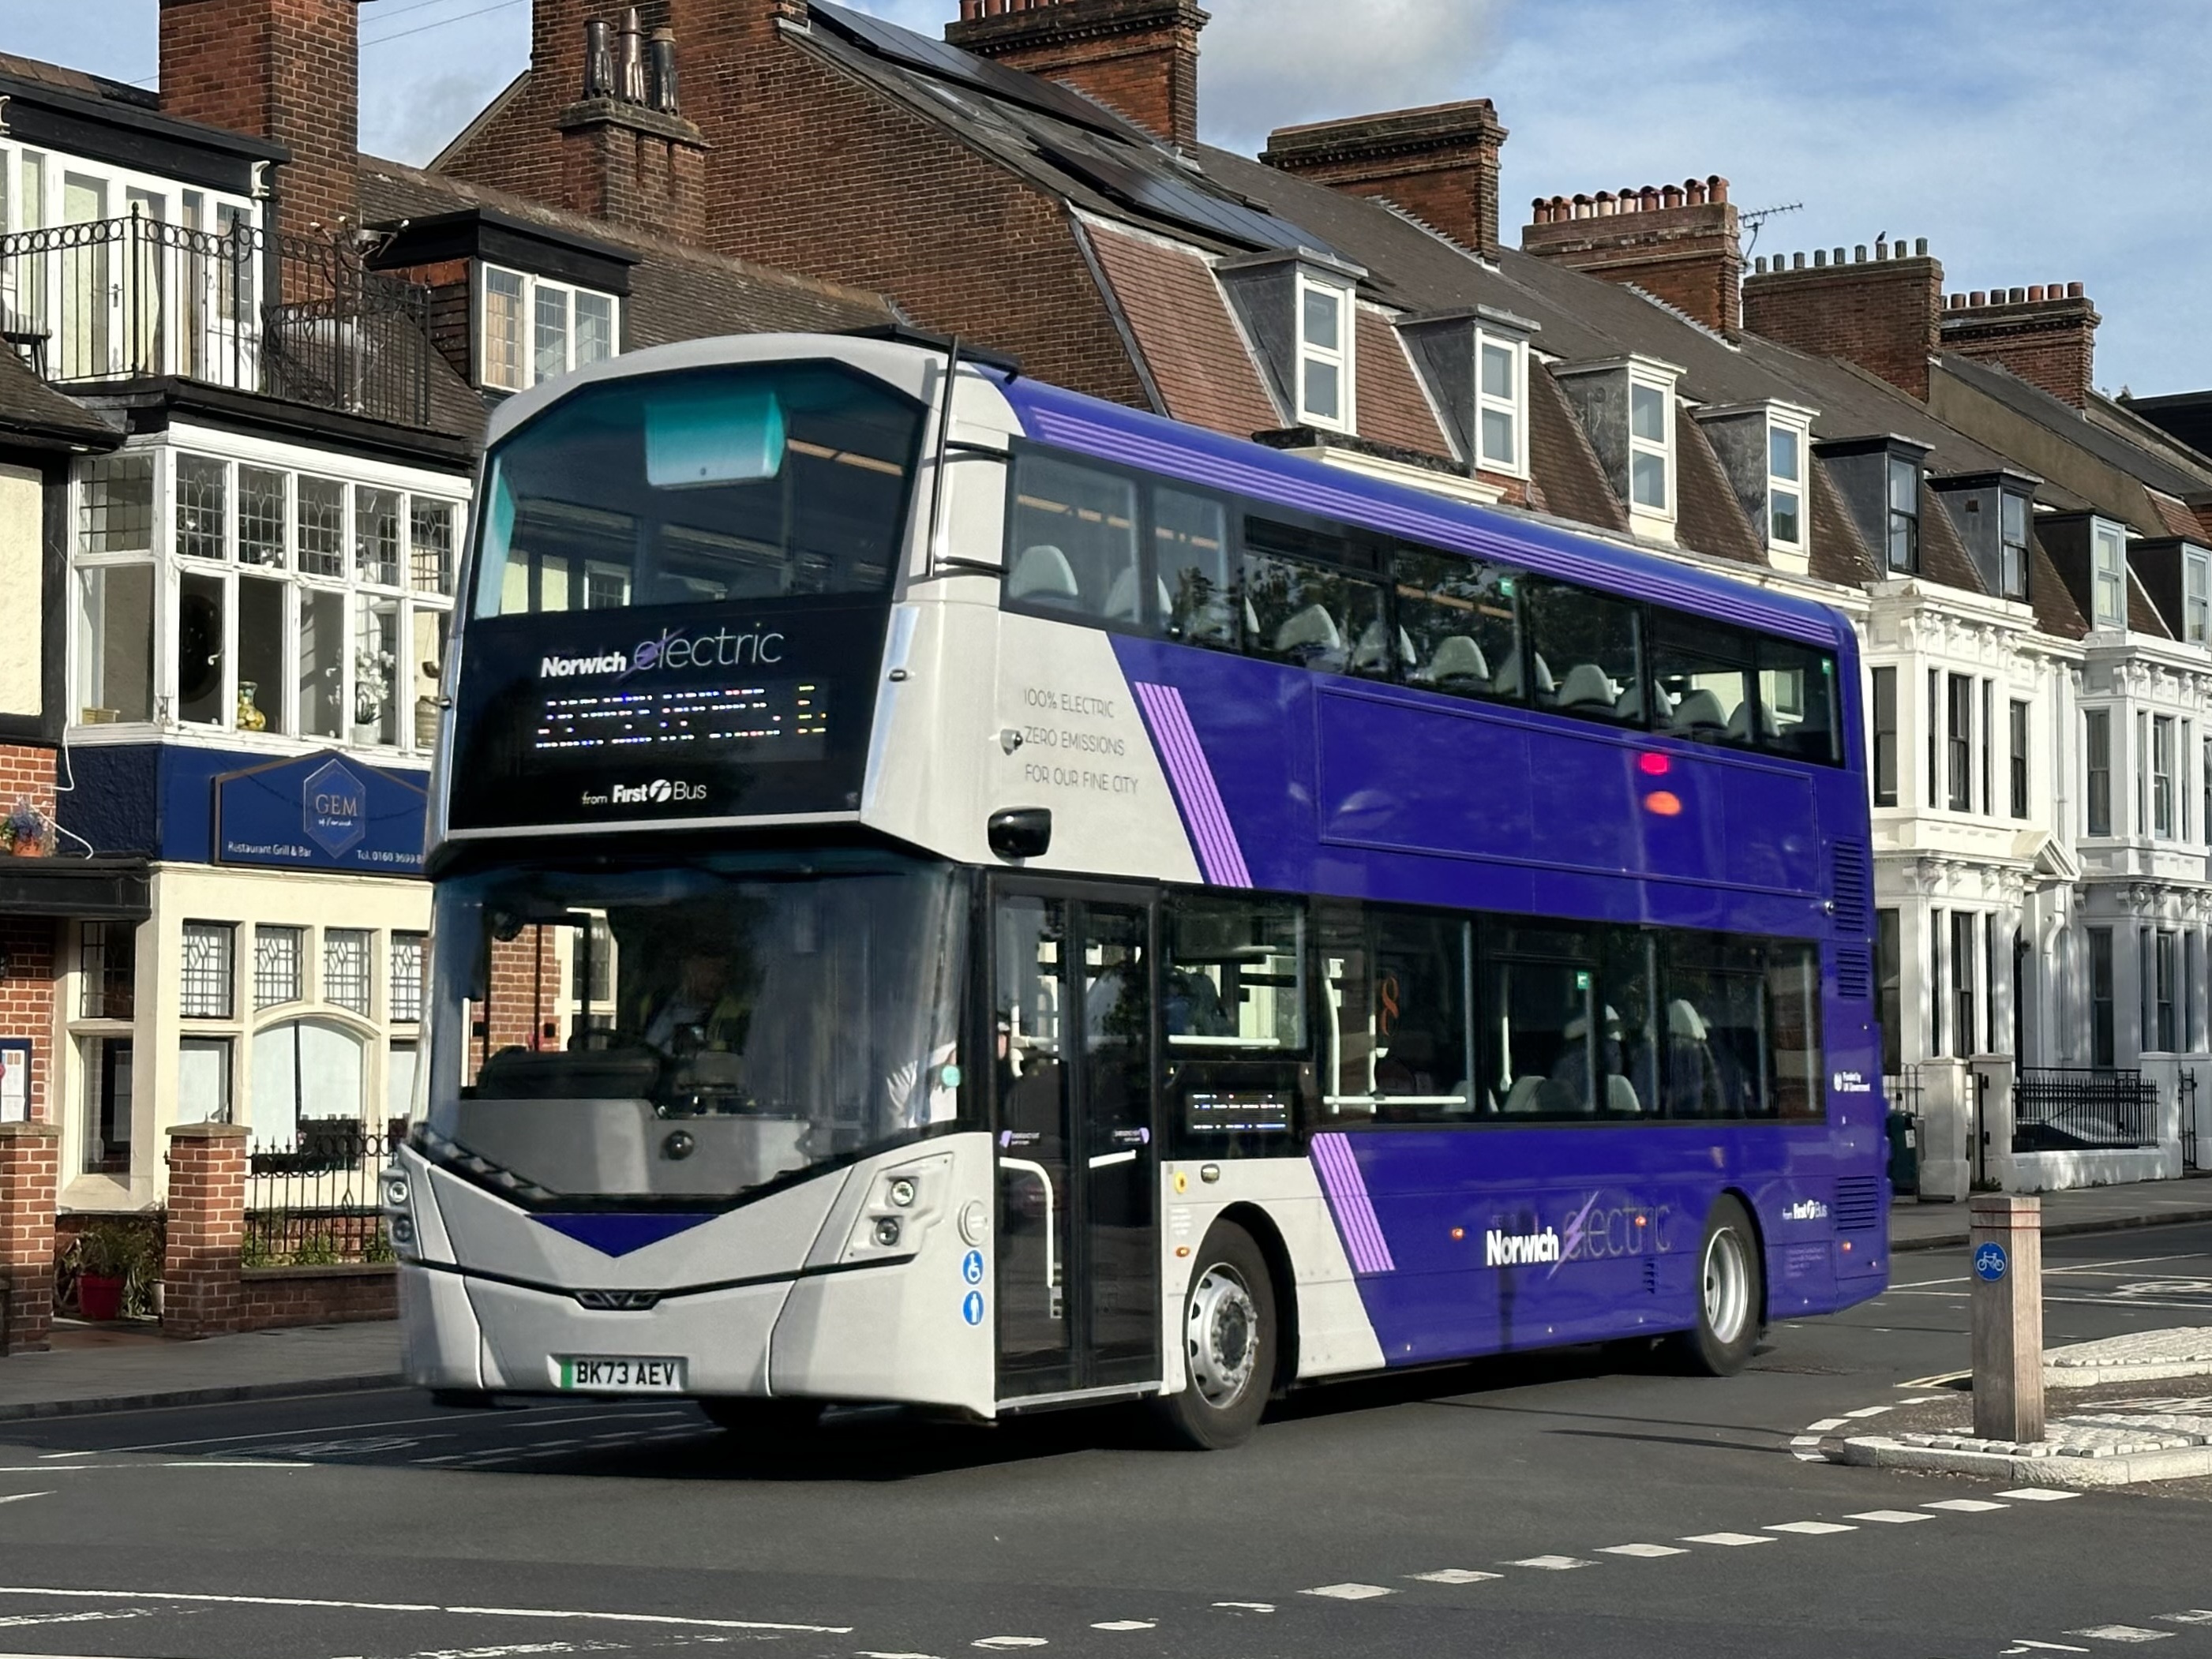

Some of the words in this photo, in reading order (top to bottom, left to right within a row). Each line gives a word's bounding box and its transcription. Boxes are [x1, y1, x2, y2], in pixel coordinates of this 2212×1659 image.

[541, 651, 628, 678] Norwich
[634, 622, 785, 670] electric
[1024, 688, 1057, 710] 100%
[1061, 694, 1115, 718] ELECTRIC
[1024, 726, 1057, 747] ZERO
[1061, 731, 1125, 756] EMISSIONS
[1025, 763, 1050, 784] FOR
[1054, 767, 1079, 787] OUR
[1082, 771, 1109, 791] FINE
[1112, 775, 1138, 794] CITY
[316, 794, 358, 816] GEM
[582, 791, 608, 805] from
[612, 784, 648, 803] First
[673, 781, 707, 800] Bus
[227, 841, 272, 855] Restaurant
[272, 844, 290, 856] Grill
[291, 845, 298, 856] &
[298, 845, 312, 857] Bar
[1815, 1200, 1828, 1218] Bus
[1487, 1226, 1559, 1266] Norwich
[576, 1361, 629, 1384] BK73
[635, 1362, 674, 1386] AEV
